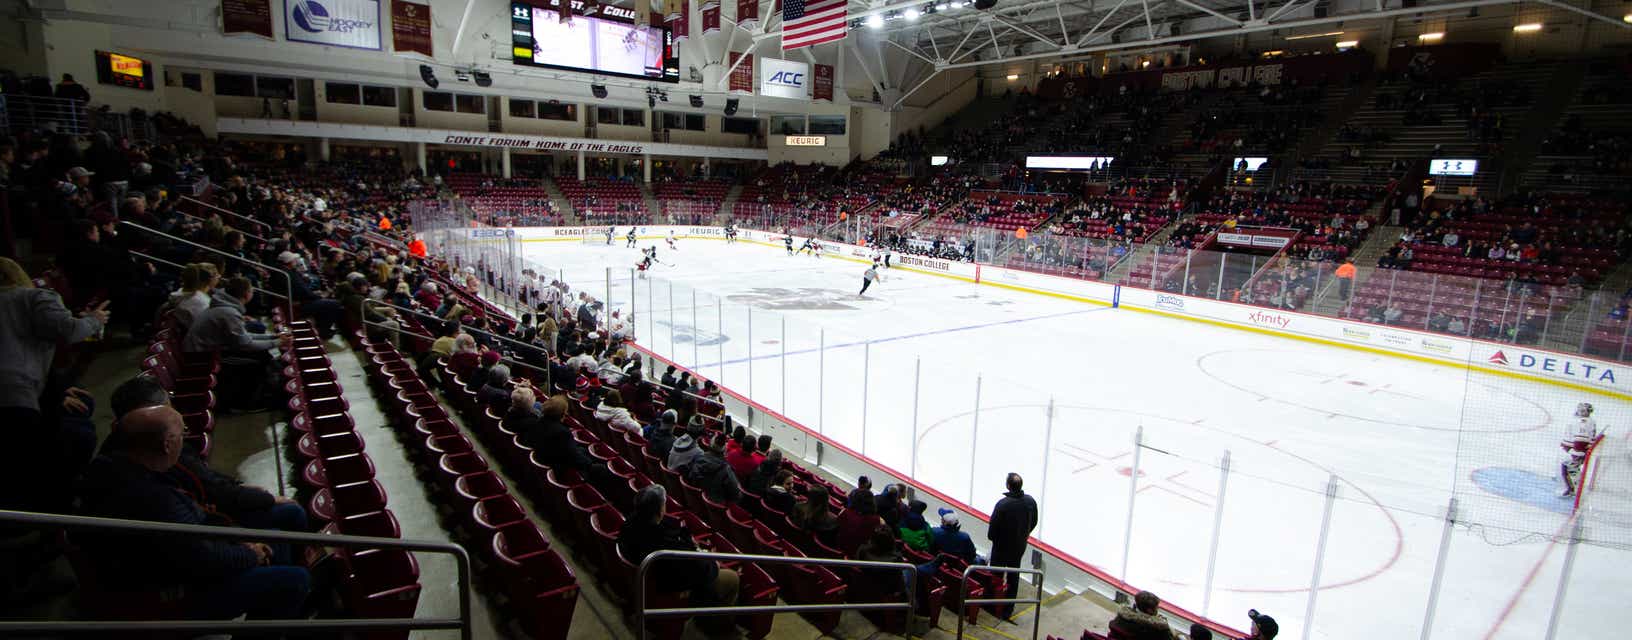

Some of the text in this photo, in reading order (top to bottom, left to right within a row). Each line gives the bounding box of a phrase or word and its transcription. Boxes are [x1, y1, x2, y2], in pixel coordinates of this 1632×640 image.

[328, 24, 353, 33] EAST
[329, 17, 373, 29] HOCKEY
[769, 71, 804, 86] ACC
[445, 135, 644, 153] CONTE FORUM HOME OF THE EAGLES
[790, 137, 821, 145] KEURIG
[689, 227, 721, 236] KEURIG
[899, 255, 950, 271] BOSTON COLLEGE
[1248, 311, 1291, 329] xfinity
[1519, 354, 1616, 384] DELTA
